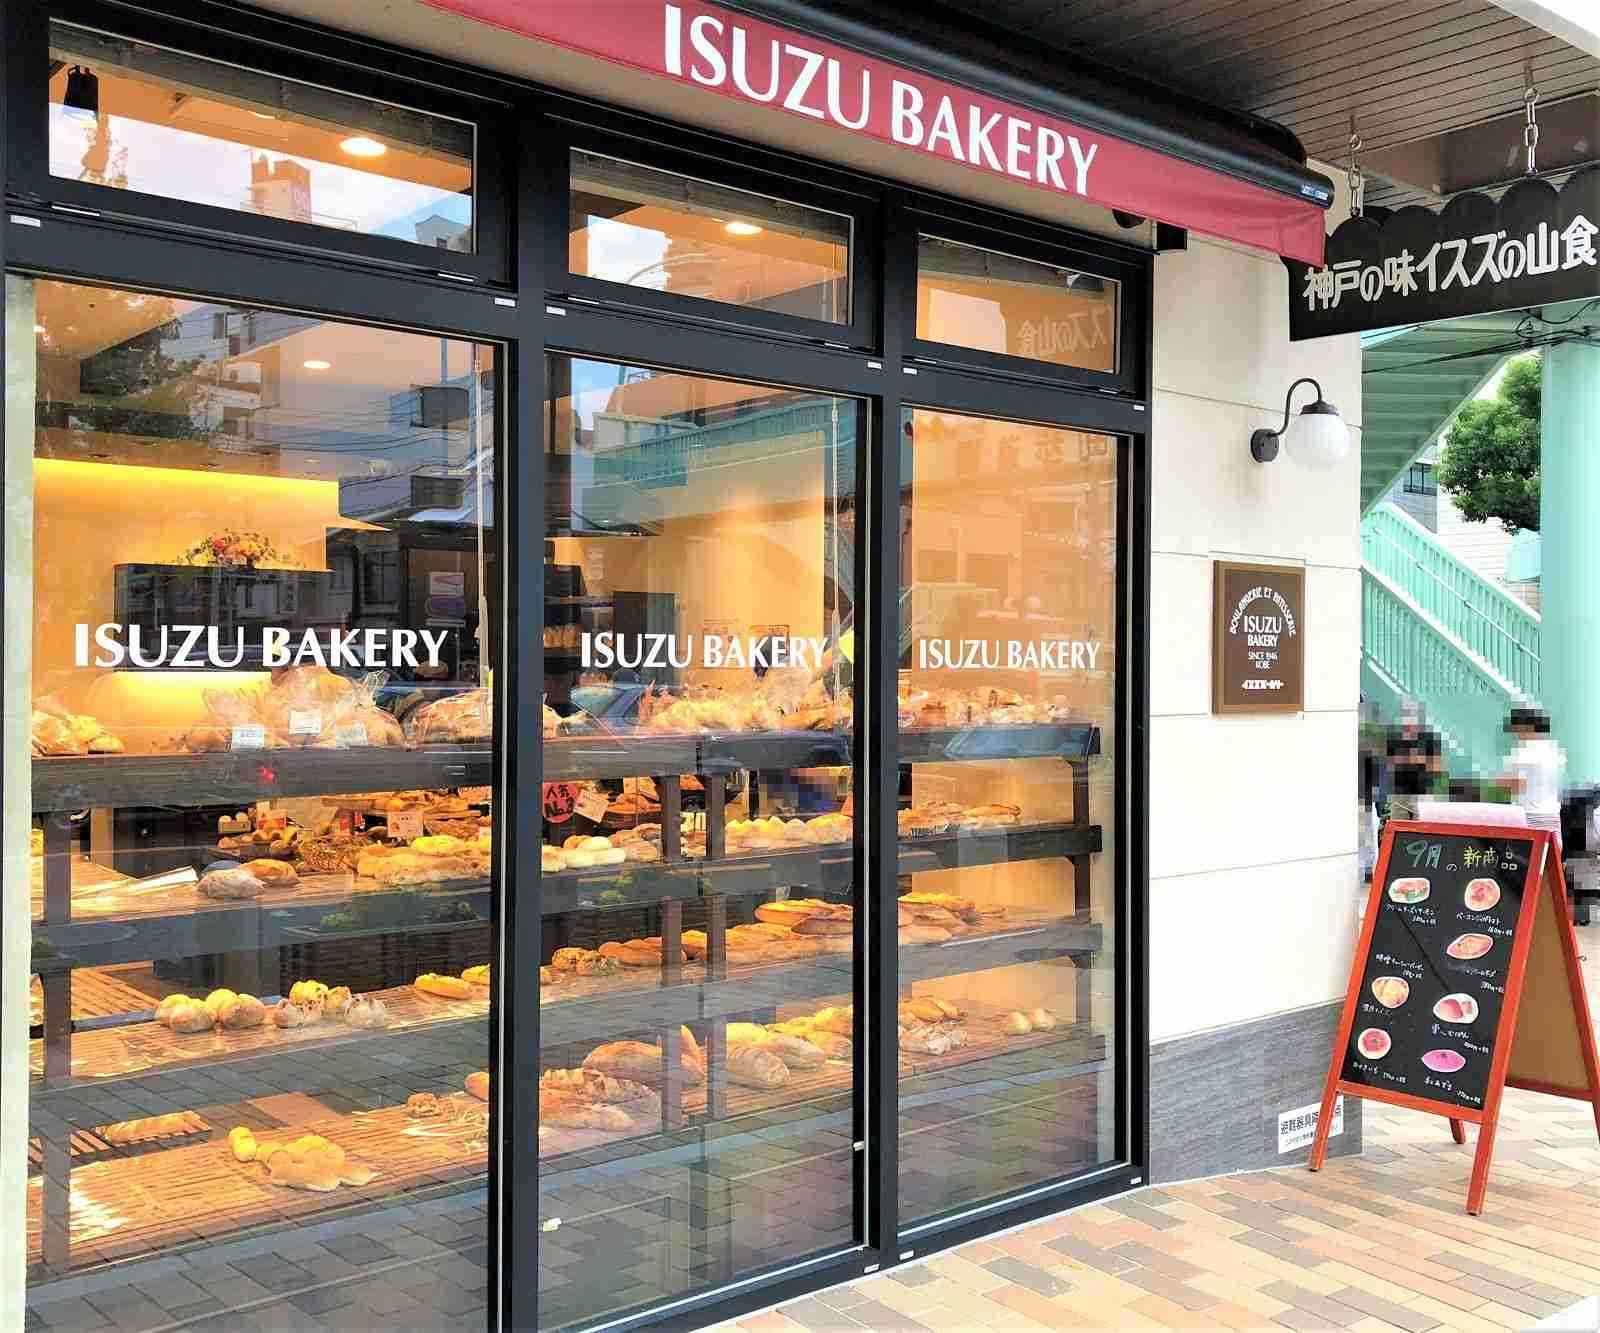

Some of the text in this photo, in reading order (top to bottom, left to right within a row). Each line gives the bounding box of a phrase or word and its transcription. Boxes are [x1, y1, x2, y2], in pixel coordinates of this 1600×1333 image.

[664, 3, 1098, 196] ISUZU BAKERY
[1302, 214, 1599, 312] 神戸の味イスズの山食
[1243, 615, 1282, 634] ISUZU
[1247, 634, 1279, 647] BAKERY
[73, 622, 449, 669] ISUZU BAKERY
[580, 630, 828, 670] ISUZU BAKERY
[918, 638, 1101, 670] ISUZU BAKERY
[1247, 651, 1264, 661] SINCE
